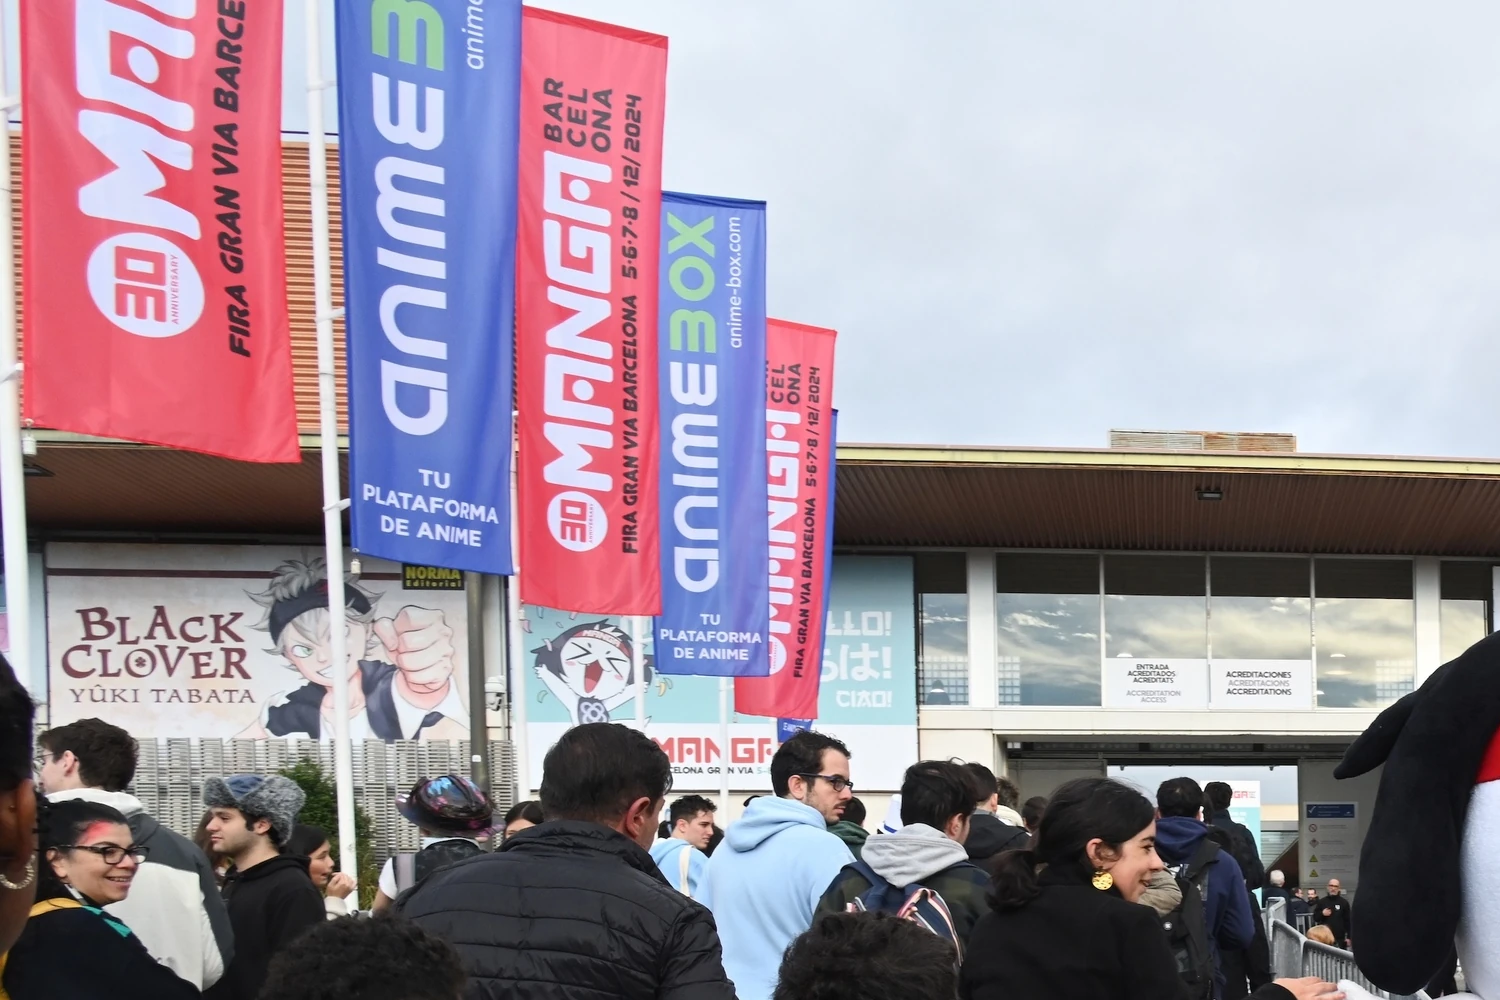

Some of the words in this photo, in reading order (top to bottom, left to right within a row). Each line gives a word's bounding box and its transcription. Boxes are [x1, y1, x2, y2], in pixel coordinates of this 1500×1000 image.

[543, 77, 563, 142] BAR
[567, 88, 587, 147] CEL
[591, 89, 612, 152] ONA
[623, 93, 642, 152] 2024
[211, 122, 238, 175] VIA
[213, 184, 243, 273] GRAN
[114, 245, 166, 322] 30
[170, 254, 179, 324] ANNIVERSARY
[725, 215, 743, 348] anime-box.com
[224, 284, 250, 357] FIRA
[543, 150, 613, 491] MANGA
[621, 294, 637, 412] BARCELONA
[770, 363, 785, 403] CEL
[786, 362, 801, 404] ONA
[808, 365, 820, 403] 2024
[623, 417, 638, 450] VIA
[418, 468, 449, 488] TU
[622, 455, 638, 506] GRAN
[363, 483, 498, 523] PLATAFORMA
[560, 498, 586, 543] 30
[380, 514, 409, 535] DE
[416, 521, 481, 546] ANIME
[622, 510, 638, 553] FIRA
[801, 497, 816, 579] BARCELONA
[405, 566, 461, 579] NORMA
[800, 581, 811, 604] VIA
[75, 605, 244, 645] BLACK
[660, 628, 761, 643] PLATAFORMA
[700, 613, 720, 625] TU
[797, 608, 810, 645] GRAN
[61, 643, 251, 679] CLOVER
[673, 646, 694, 658] DE
[698, 647, 749, 660] ANIME
[793, 648, 805, 678] FIRA
[150, 688, 256, 703] TABATA
[738, 766, 753, 774] VIA
